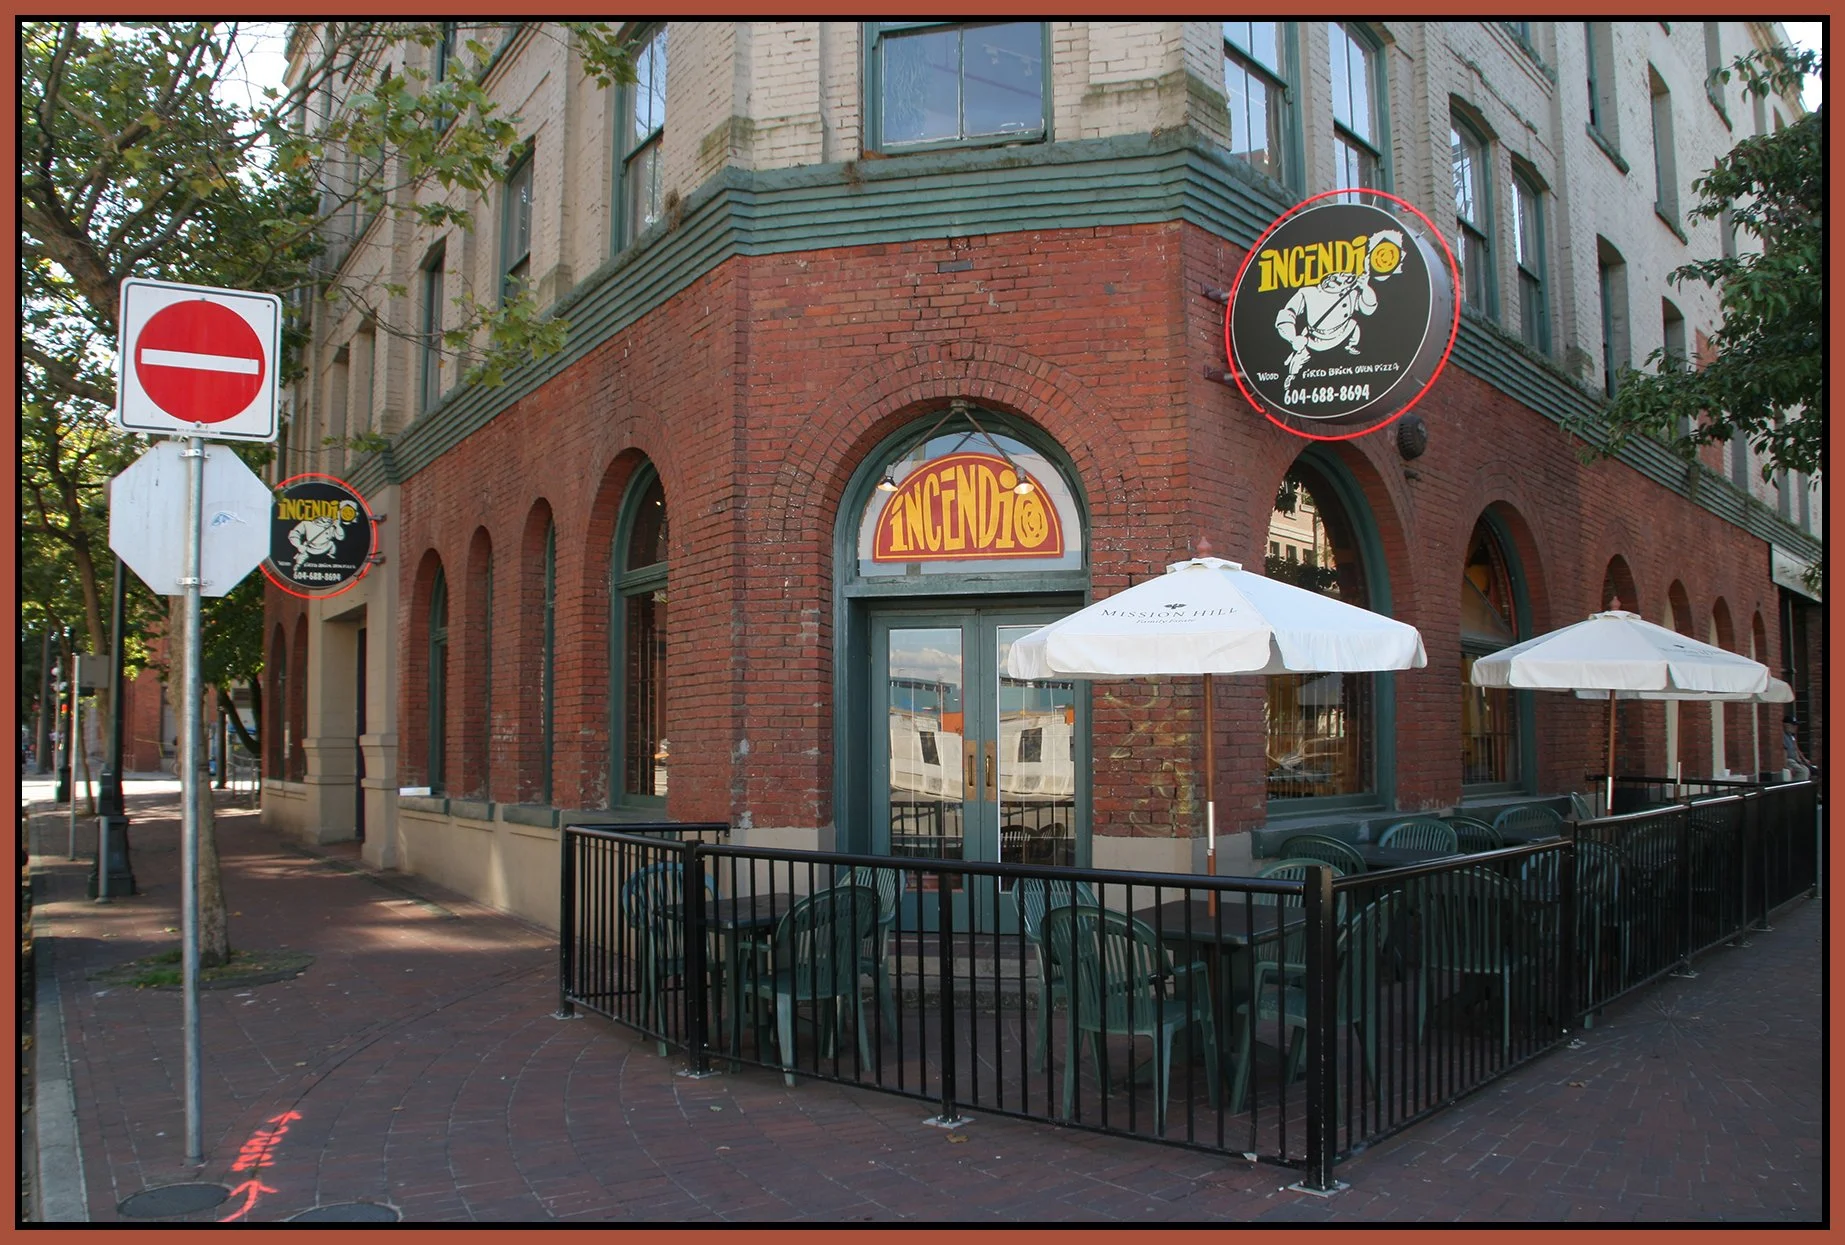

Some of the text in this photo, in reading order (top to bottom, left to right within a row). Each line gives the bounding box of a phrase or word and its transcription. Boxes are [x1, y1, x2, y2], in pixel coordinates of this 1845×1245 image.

[1284, 384, 1370, 404] 604-688-8694
[1101, 607, 1237, 617] MISSION HILL
